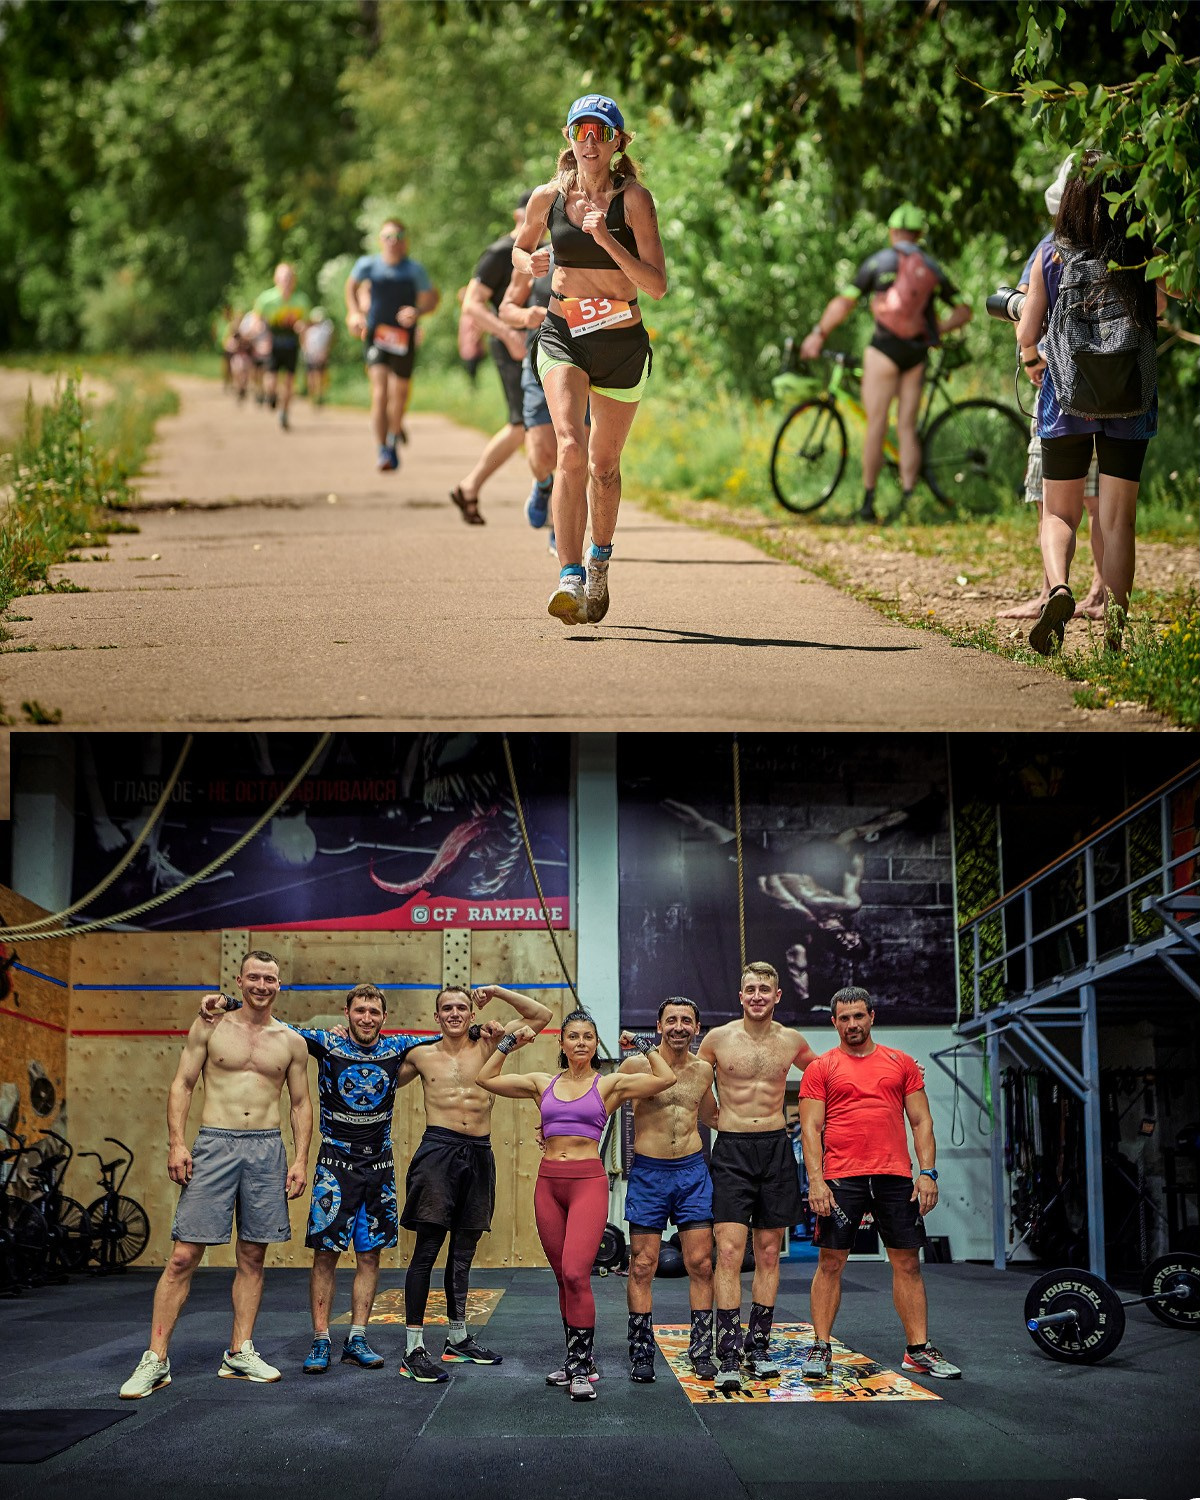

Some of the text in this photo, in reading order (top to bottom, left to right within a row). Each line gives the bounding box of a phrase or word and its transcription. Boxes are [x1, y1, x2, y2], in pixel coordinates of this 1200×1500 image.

[572, 96, 612, 114] UFC
[579, 298, 612, 320] 53
[113, 780, 193, 802] ГЛАВОЕ
[209, 780, 230, 801] НЕ
[321, 1157, 353, 1171] GUTTA
[1040, 1281, 1102, 1310] YOUSTEEL
